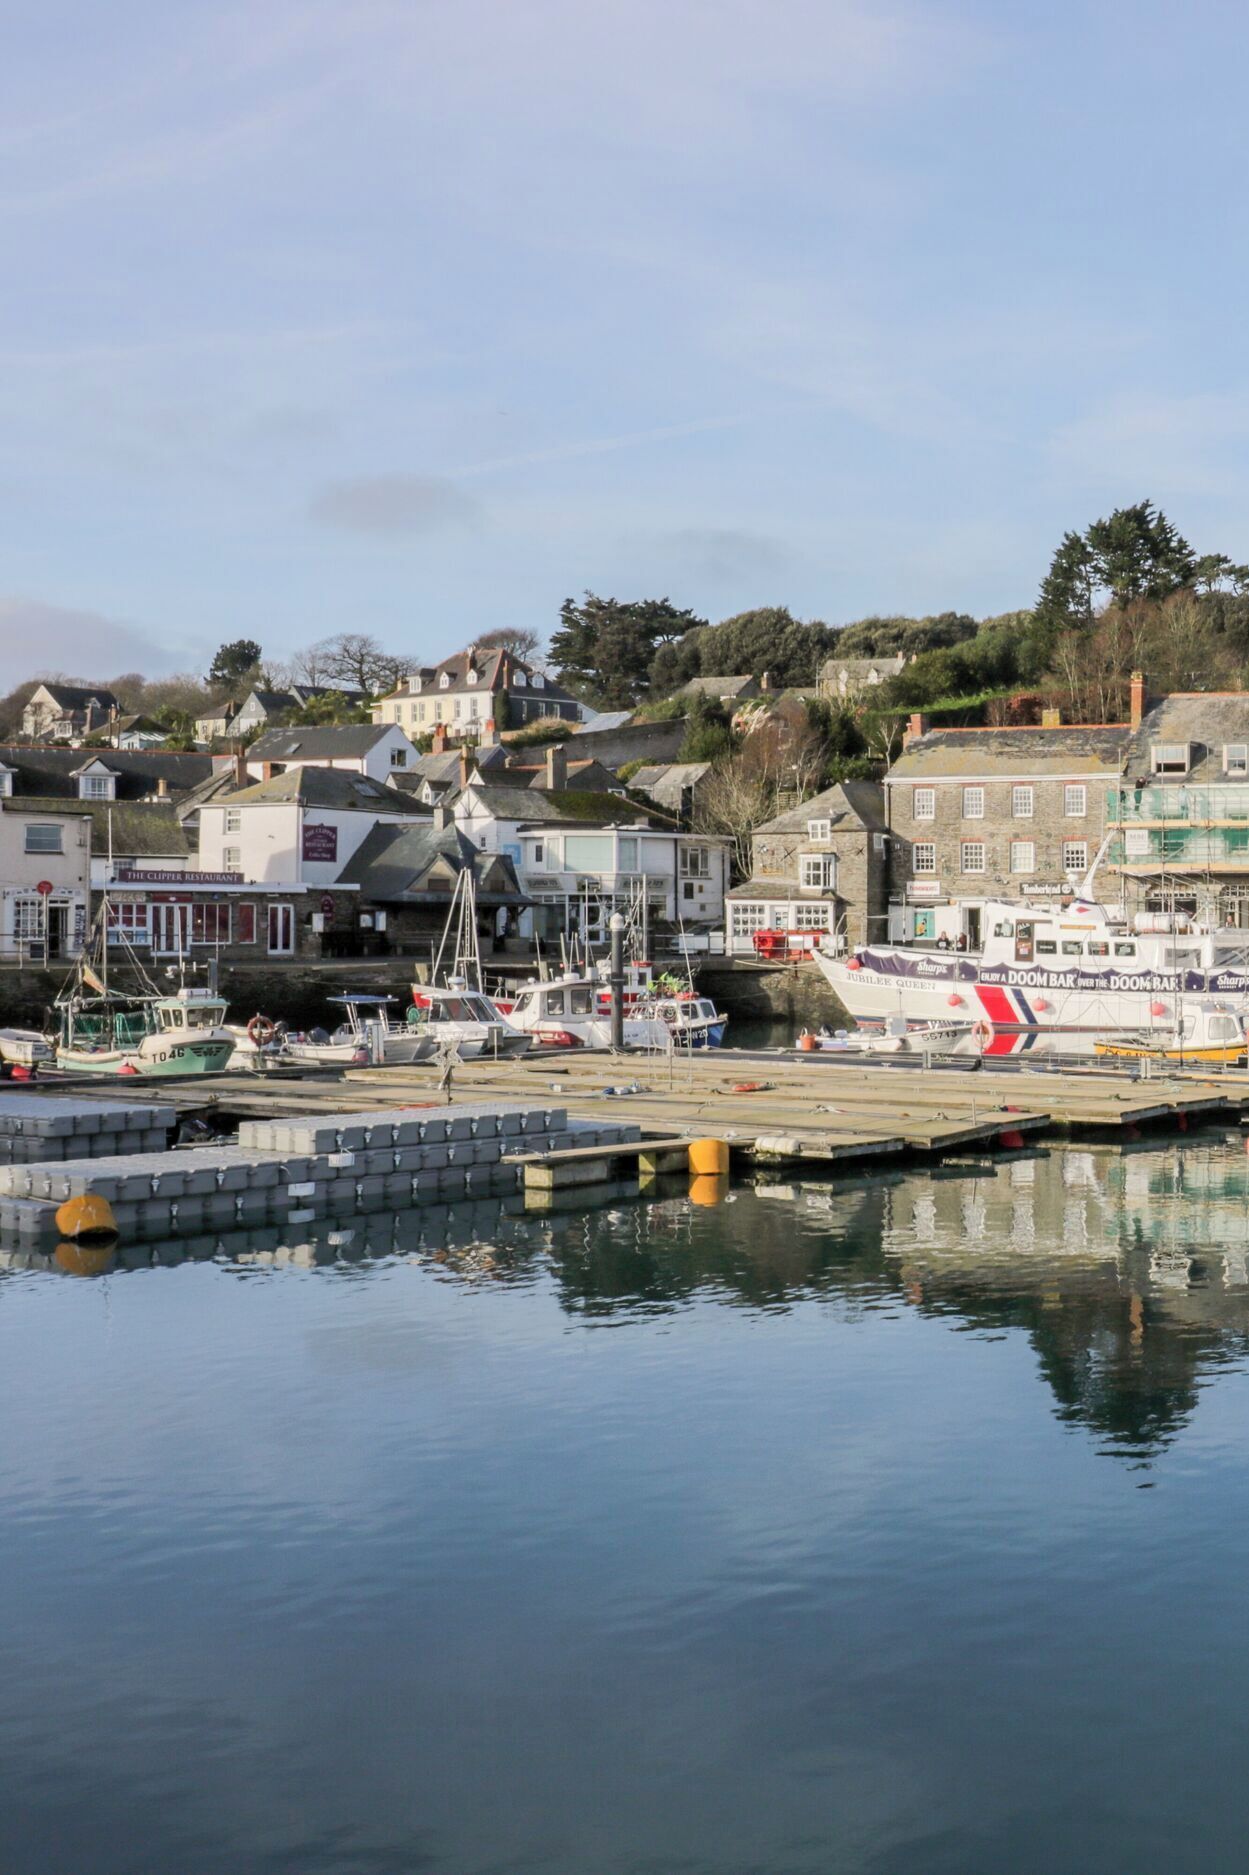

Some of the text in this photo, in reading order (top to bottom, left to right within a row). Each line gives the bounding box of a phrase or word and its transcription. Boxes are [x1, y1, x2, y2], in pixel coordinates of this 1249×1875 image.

[127, 871, 239, 881] THE CLIPPER RESTAURANT
[917, 961, 948, 976] Sharp's
[847, 972, 937, 991] JUBILEE QUEEN
[981, 972, 1000, 982] ENJOY
[1001, 974, 1006, 982] A
[1008, 970, 1047, 986] DOOM
[1078, 977, 1095, 987] OVER
[1095, 978, 1108, 988] THE
[1110, 975, 1150, 991] DOOM
